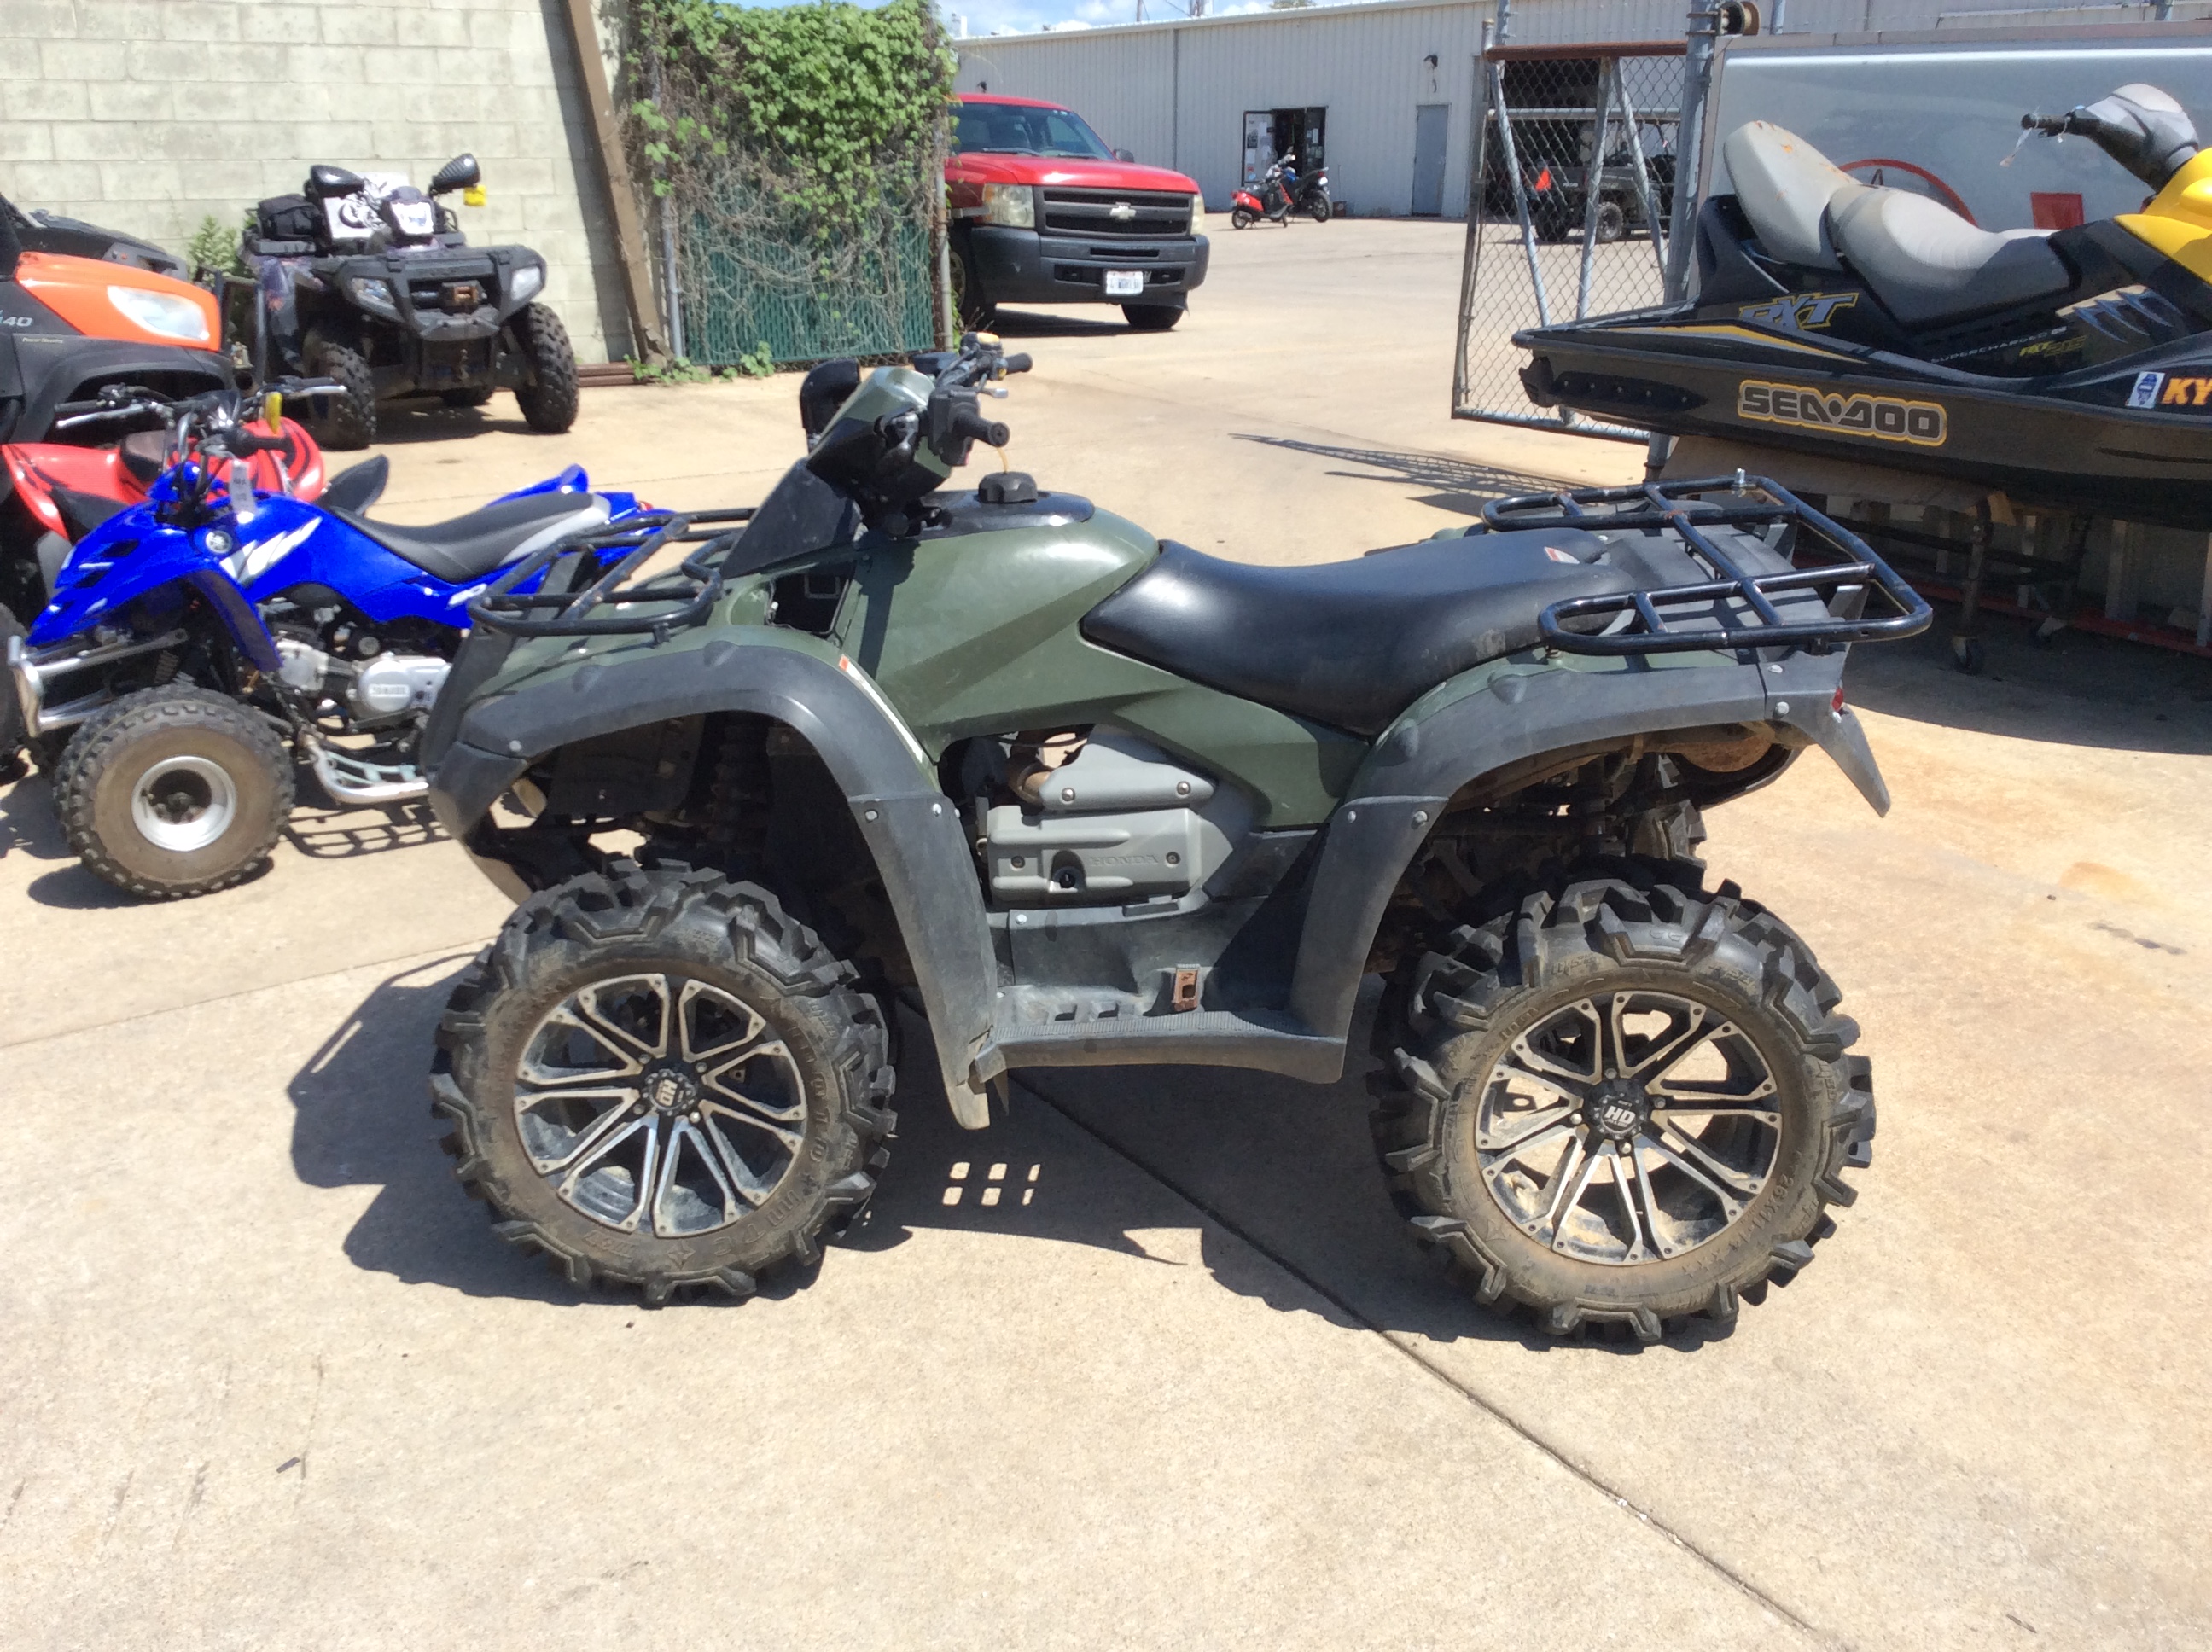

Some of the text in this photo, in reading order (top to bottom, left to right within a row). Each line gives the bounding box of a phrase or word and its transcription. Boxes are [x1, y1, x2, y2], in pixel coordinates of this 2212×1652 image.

[1740, 294, 1858, 331] RXT
[1090, 854, 1159, 867] HONDA
[1604, 1105, 1636, 1125] HD
